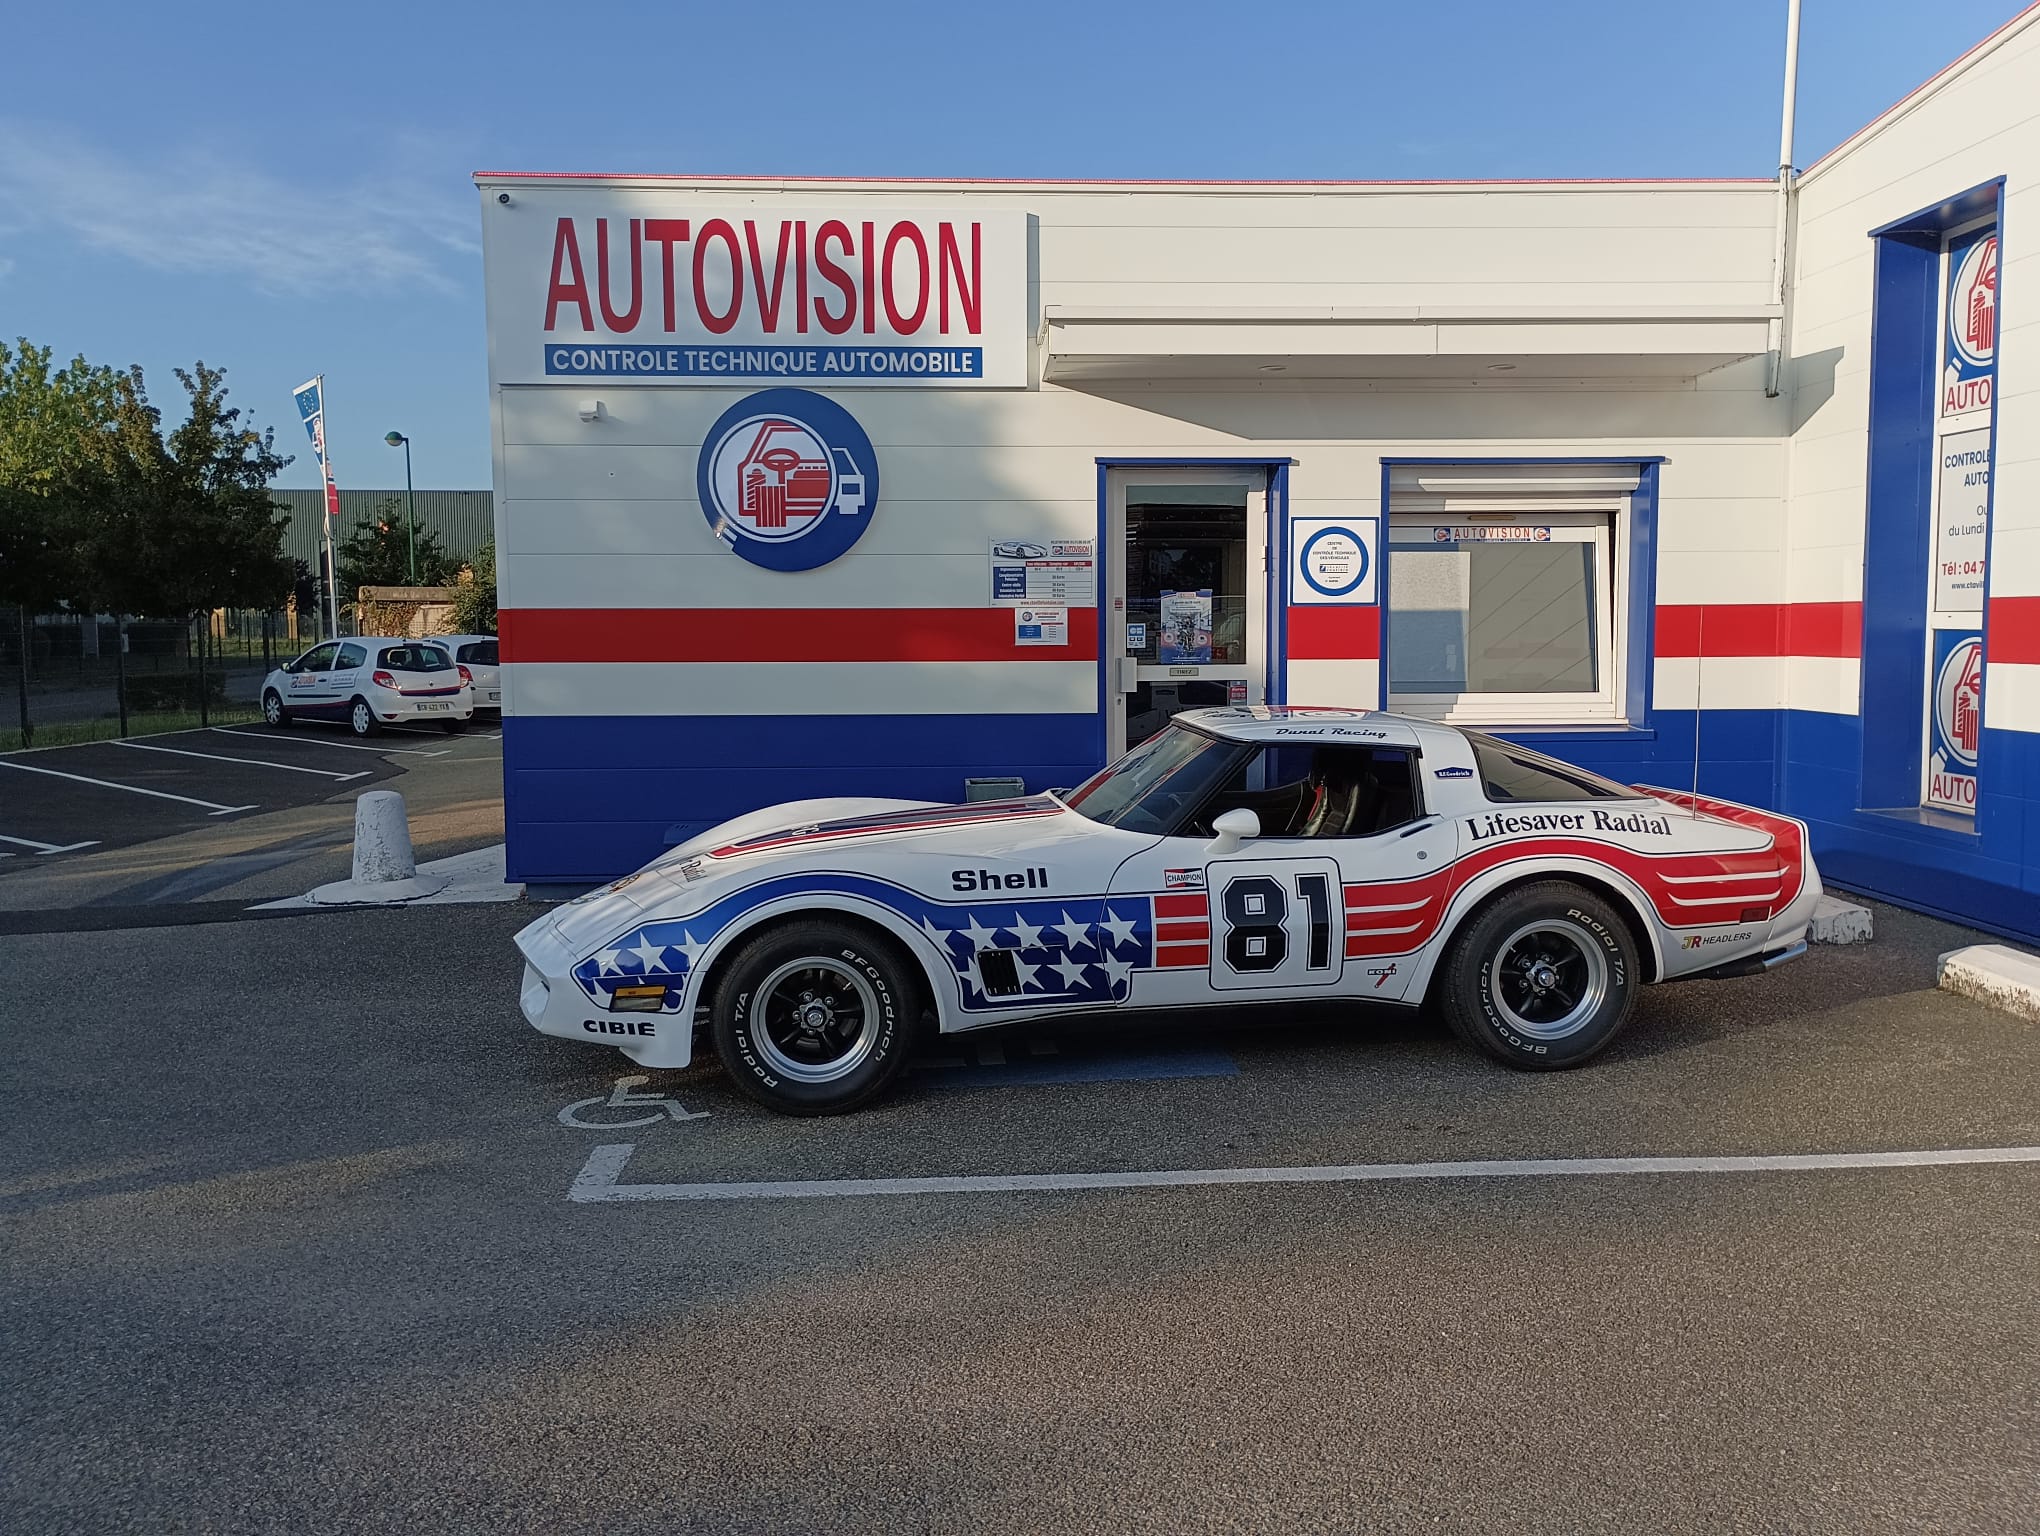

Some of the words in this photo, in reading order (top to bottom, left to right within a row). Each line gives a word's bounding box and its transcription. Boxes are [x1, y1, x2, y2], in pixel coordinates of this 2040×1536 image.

[543, 217, 982, 335] AUTOVISION
[552, 349, 679, 372] CONTROLE
[684, 350, 817, 375] TECHNIQUE
[823, 351, 974, 374] AUTOMOBILE
[1945, 378, 1991, 413] AUTO
[1964, 470, 1989, 487] AUTO
[1454, 527, 1530, 538] AUTOVISION
[1949, 524, 1959, 536] du
[1961, 522, 1985, 536] Lundi
[1964, 561, 1977, 574] 04
[1331, 727, 1389, 739] Racing
[1932, 773, 1976, 804] AUTO
[1465, 813, 1585, 840] Lifesaver
[1592, 810, 1673, 836] Radial
[951, 867, 1048, 891] Shell
[1167, 873, 1202, 882] CHAMPION
[1220, 872, 1333, 974] 81
[1566, 908, 1619, 953] Radial
[1613, 957, 1625, 986] T/A
[1681, 935, 1702, 949] JR
[1702, 931, 1753, 945] HEADLERS
[734, 992, 749, 1022] T/A
[841, 949, 895, 1062] BFGoodrich
[1480, 962, 1548, 1055] BFGoodrich
[735, 1029, 779, 1088] Radial
